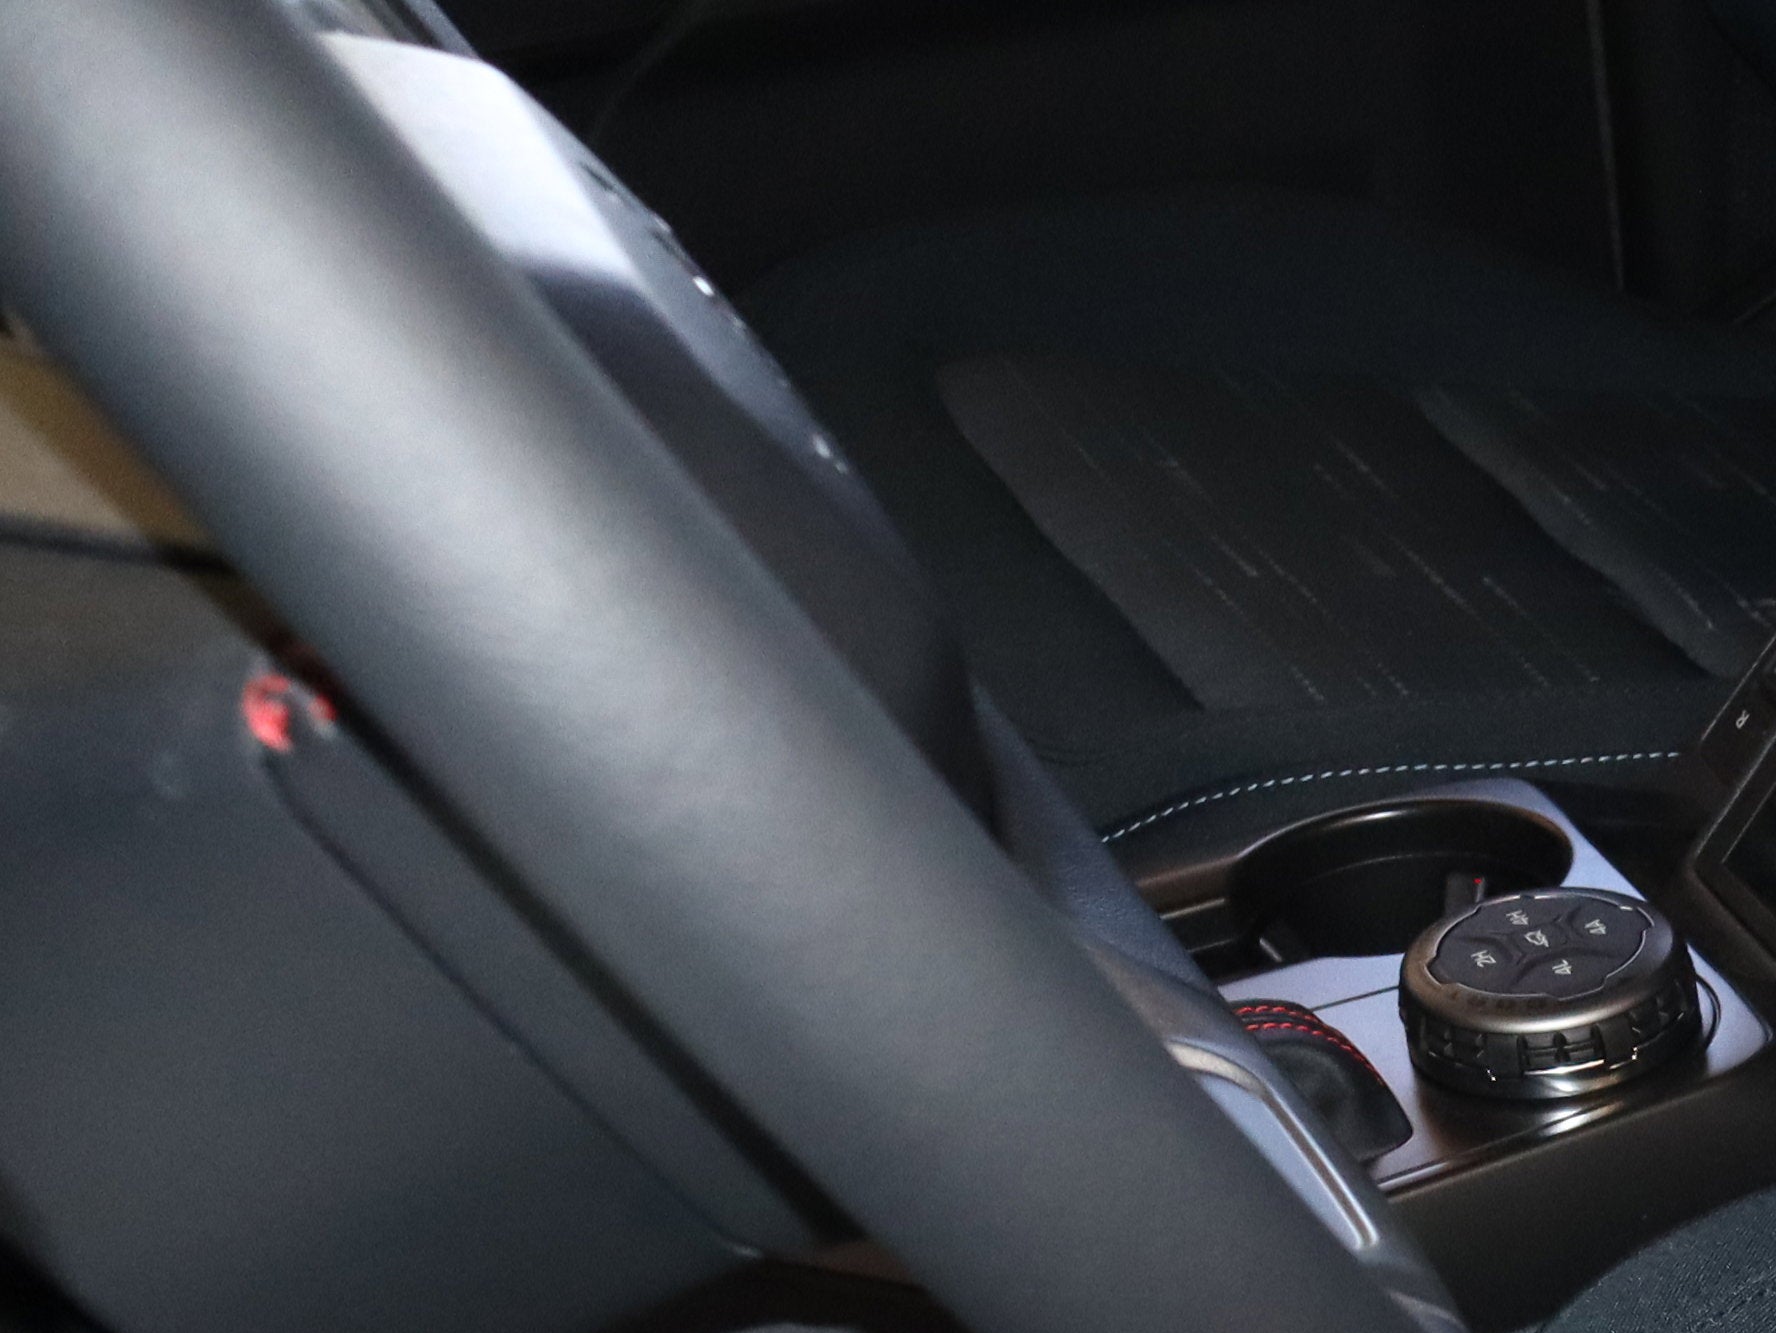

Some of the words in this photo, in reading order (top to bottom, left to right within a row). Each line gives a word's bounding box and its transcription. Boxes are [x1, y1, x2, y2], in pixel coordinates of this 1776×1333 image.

[1506, 909, 1529, 926] 4H
[1584, 918, 1607, 935] 4A
[1471, 950, 1497, 968] 2H
[1552, 959, 1572, 976] 4L
